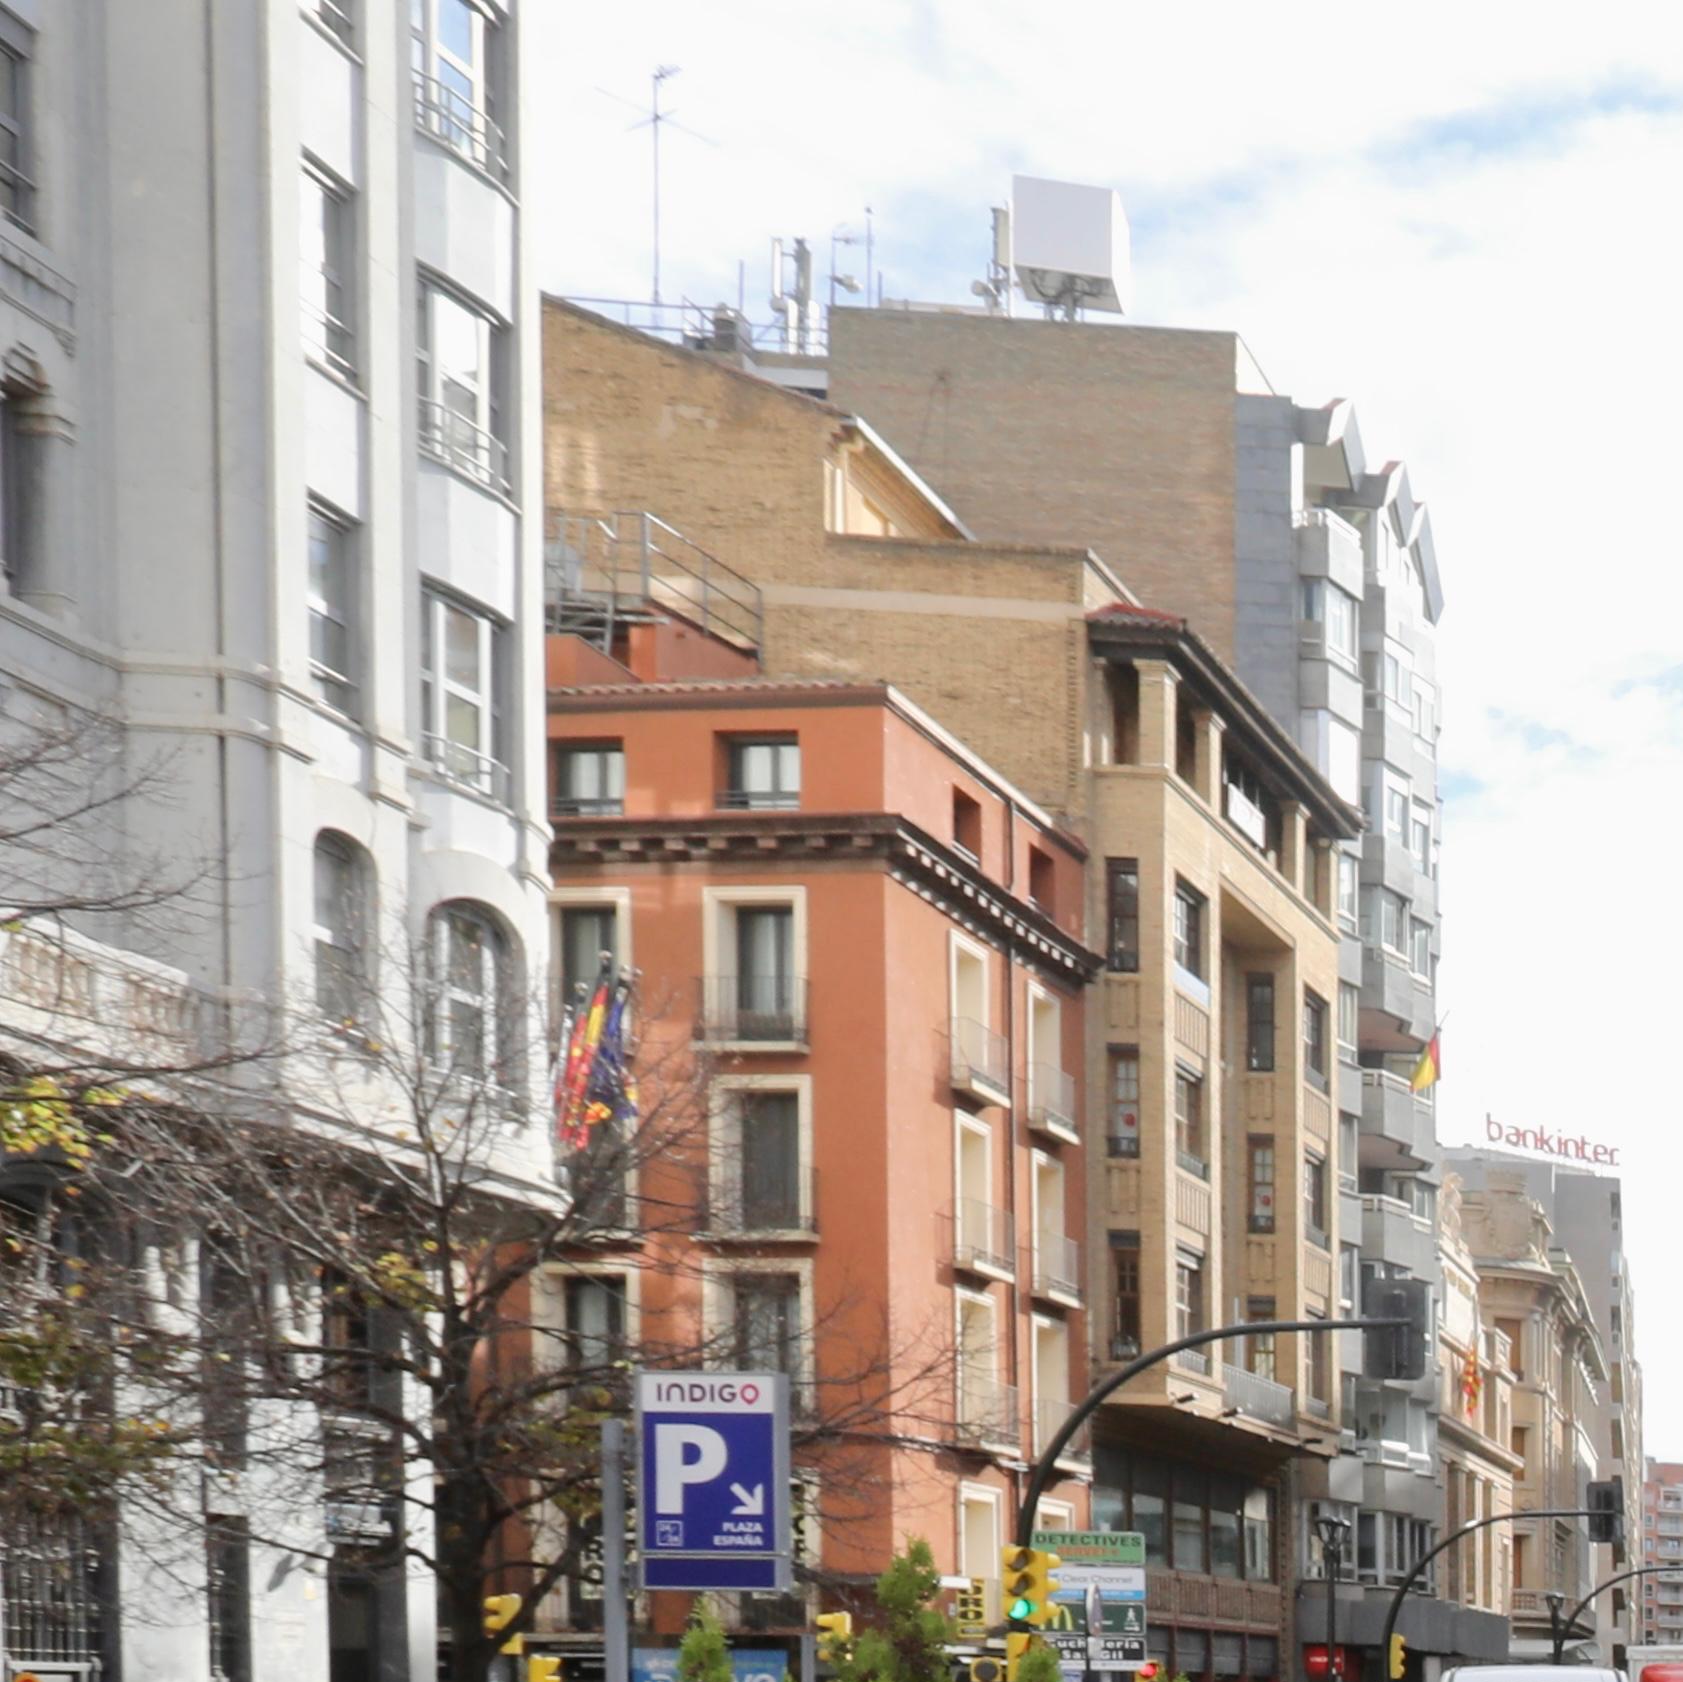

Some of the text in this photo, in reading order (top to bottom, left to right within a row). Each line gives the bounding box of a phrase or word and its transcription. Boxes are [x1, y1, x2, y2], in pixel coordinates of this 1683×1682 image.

[656, 1383, 760, 1405] INDIGO
[655, 1423, 728, 1514] P
[722, 1522, 763, 1533] PLAZA
[713, 1535, 763, 1546] ESPAÑA
[1034, 1533, 1142, 1547] DETECTIVES
[1061, 1573, 1134, 1584] Clear Channel
[1061, 1650, 1086, 1659] Sa
